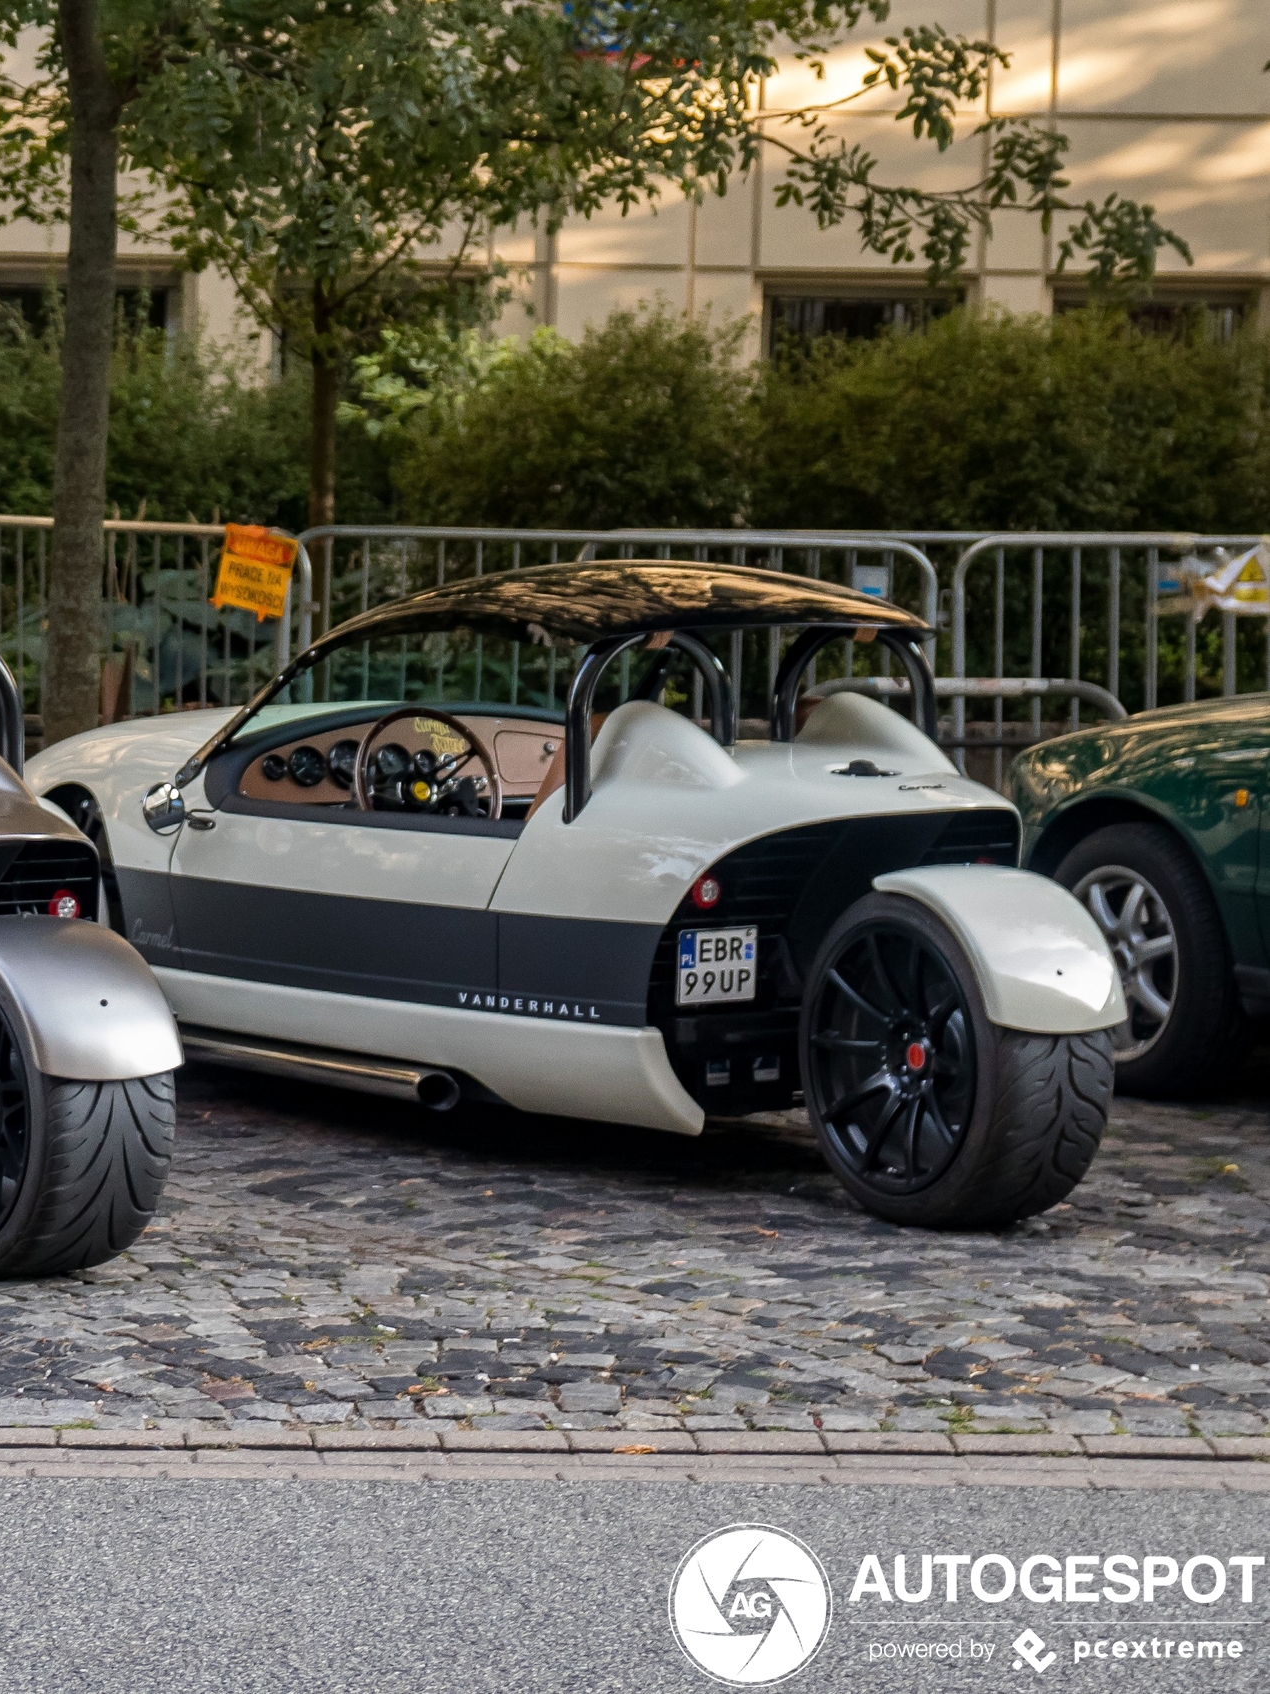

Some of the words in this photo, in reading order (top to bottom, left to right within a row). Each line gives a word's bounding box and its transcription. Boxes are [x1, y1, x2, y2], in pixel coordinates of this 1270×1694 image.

[228, 561, 264, 582] PRACE
[267, 571, 282, 587] NA
[131, 917, 174, 948] Carmel
[681, 954, 695, 966] PL
[699, 936, 743, 963] EBR
[685, 968, 751, 996] 99UP
[458, 992, 600, 1019] VANDERHALL
